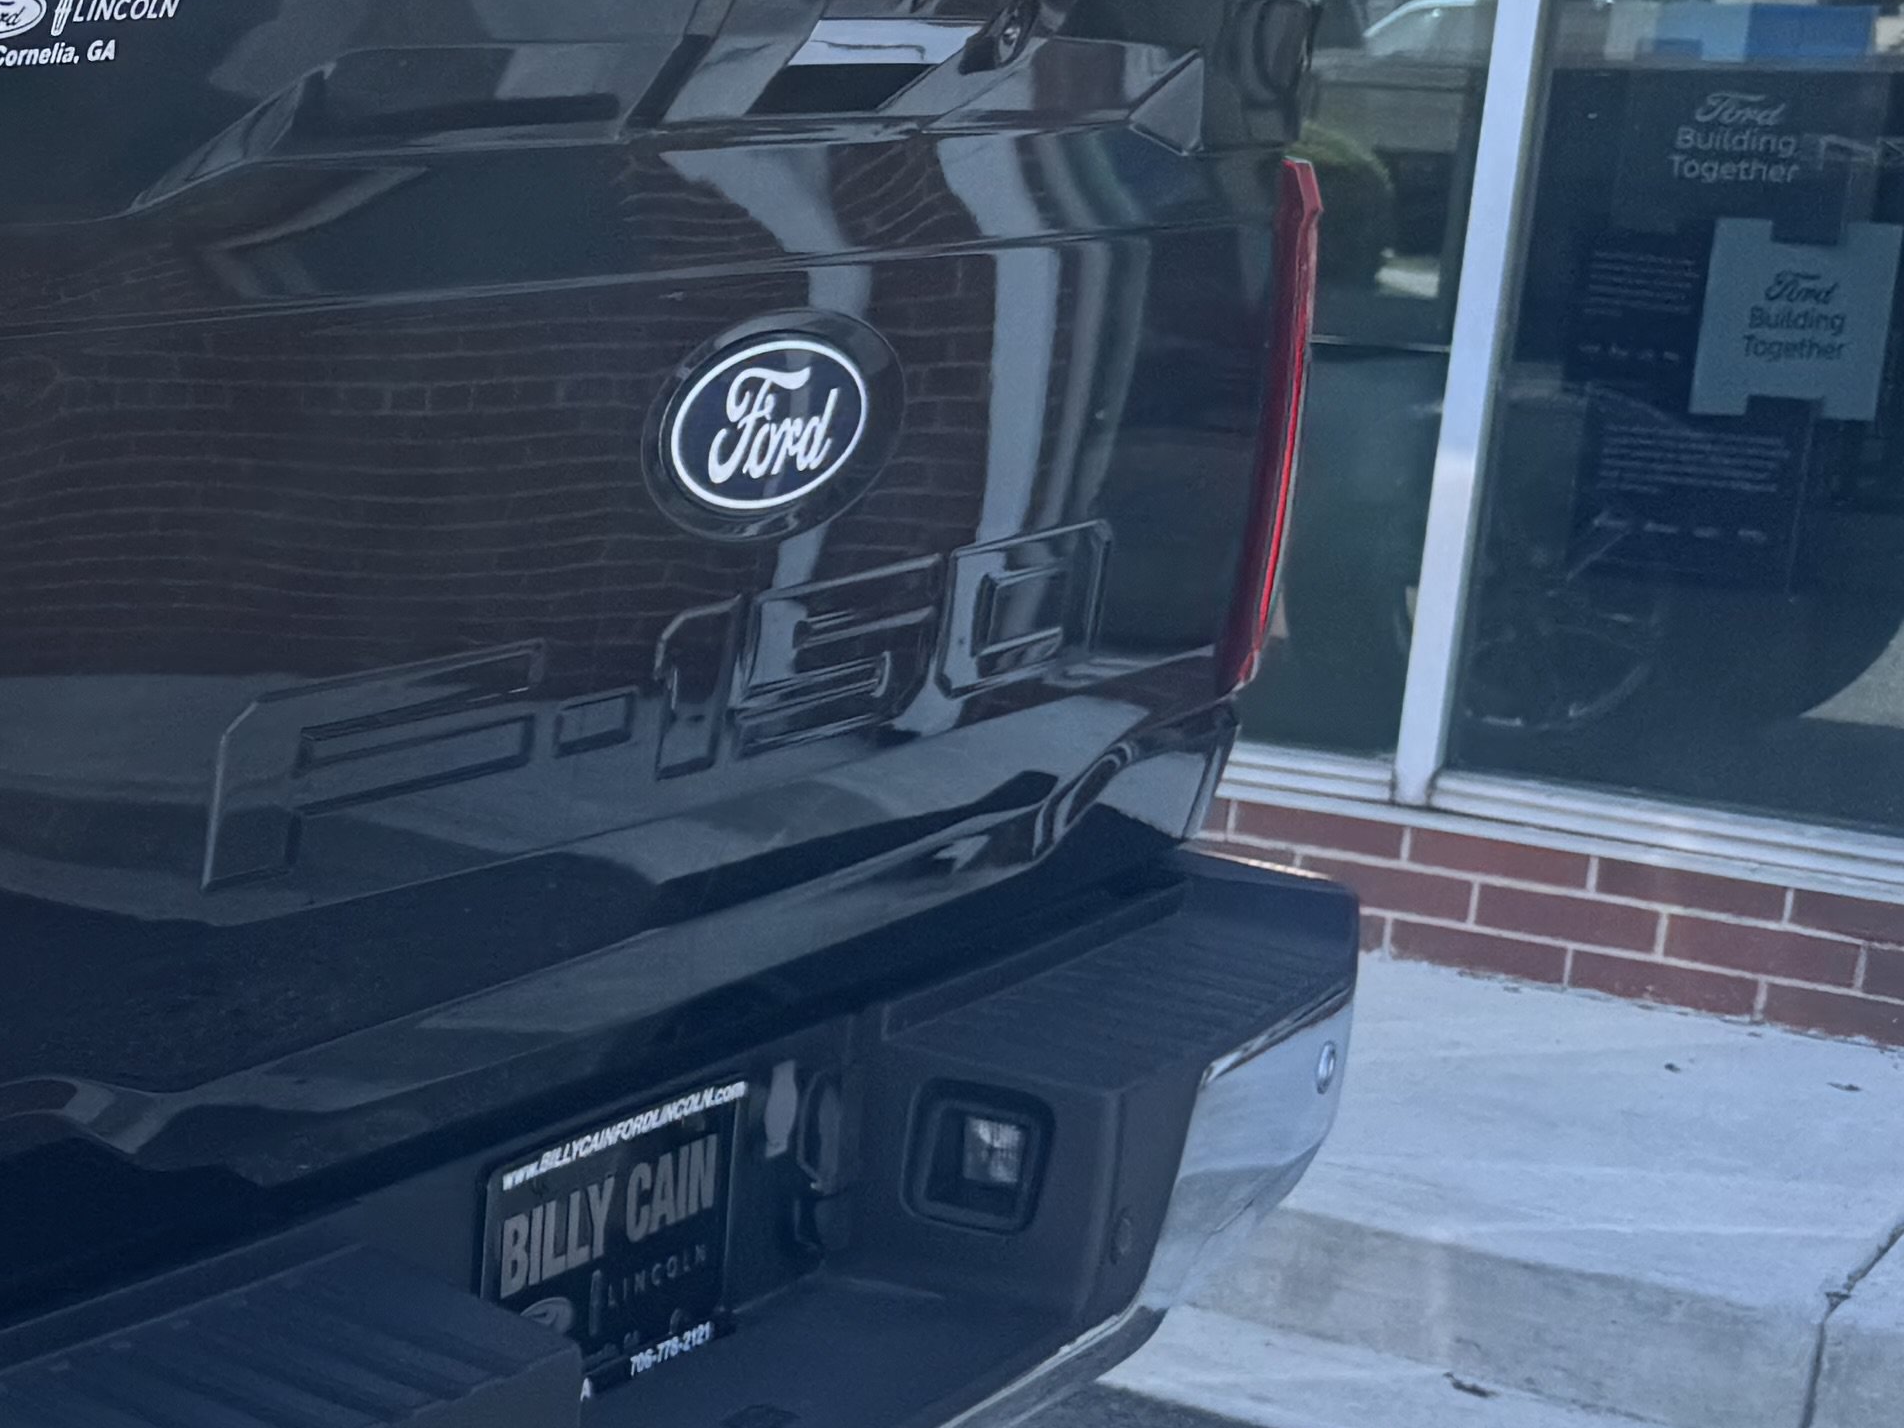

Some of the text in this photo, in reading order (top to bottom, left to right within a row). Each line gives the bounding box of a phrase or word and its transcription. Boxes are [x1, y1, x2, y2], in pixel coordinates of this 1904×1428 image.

[87, 40, 116, 63] GA
[1695, 91, 1786, 126] Ford
[1676, 126, 1797, 158] Building
[1668, 154, 1799, 184] Together
[1765, 270, 1839, 303] Ford
[1748, 307, 1847, 335] Building
[1742, 334, 1848, 362] Together
[708, 364, 842, 484] Ford
[202, 517, 1114, 890] F-150
[500, 1134, 718, 1300] BILLY CAIN
[607, 1243, 708, 1308] LINCOLN
